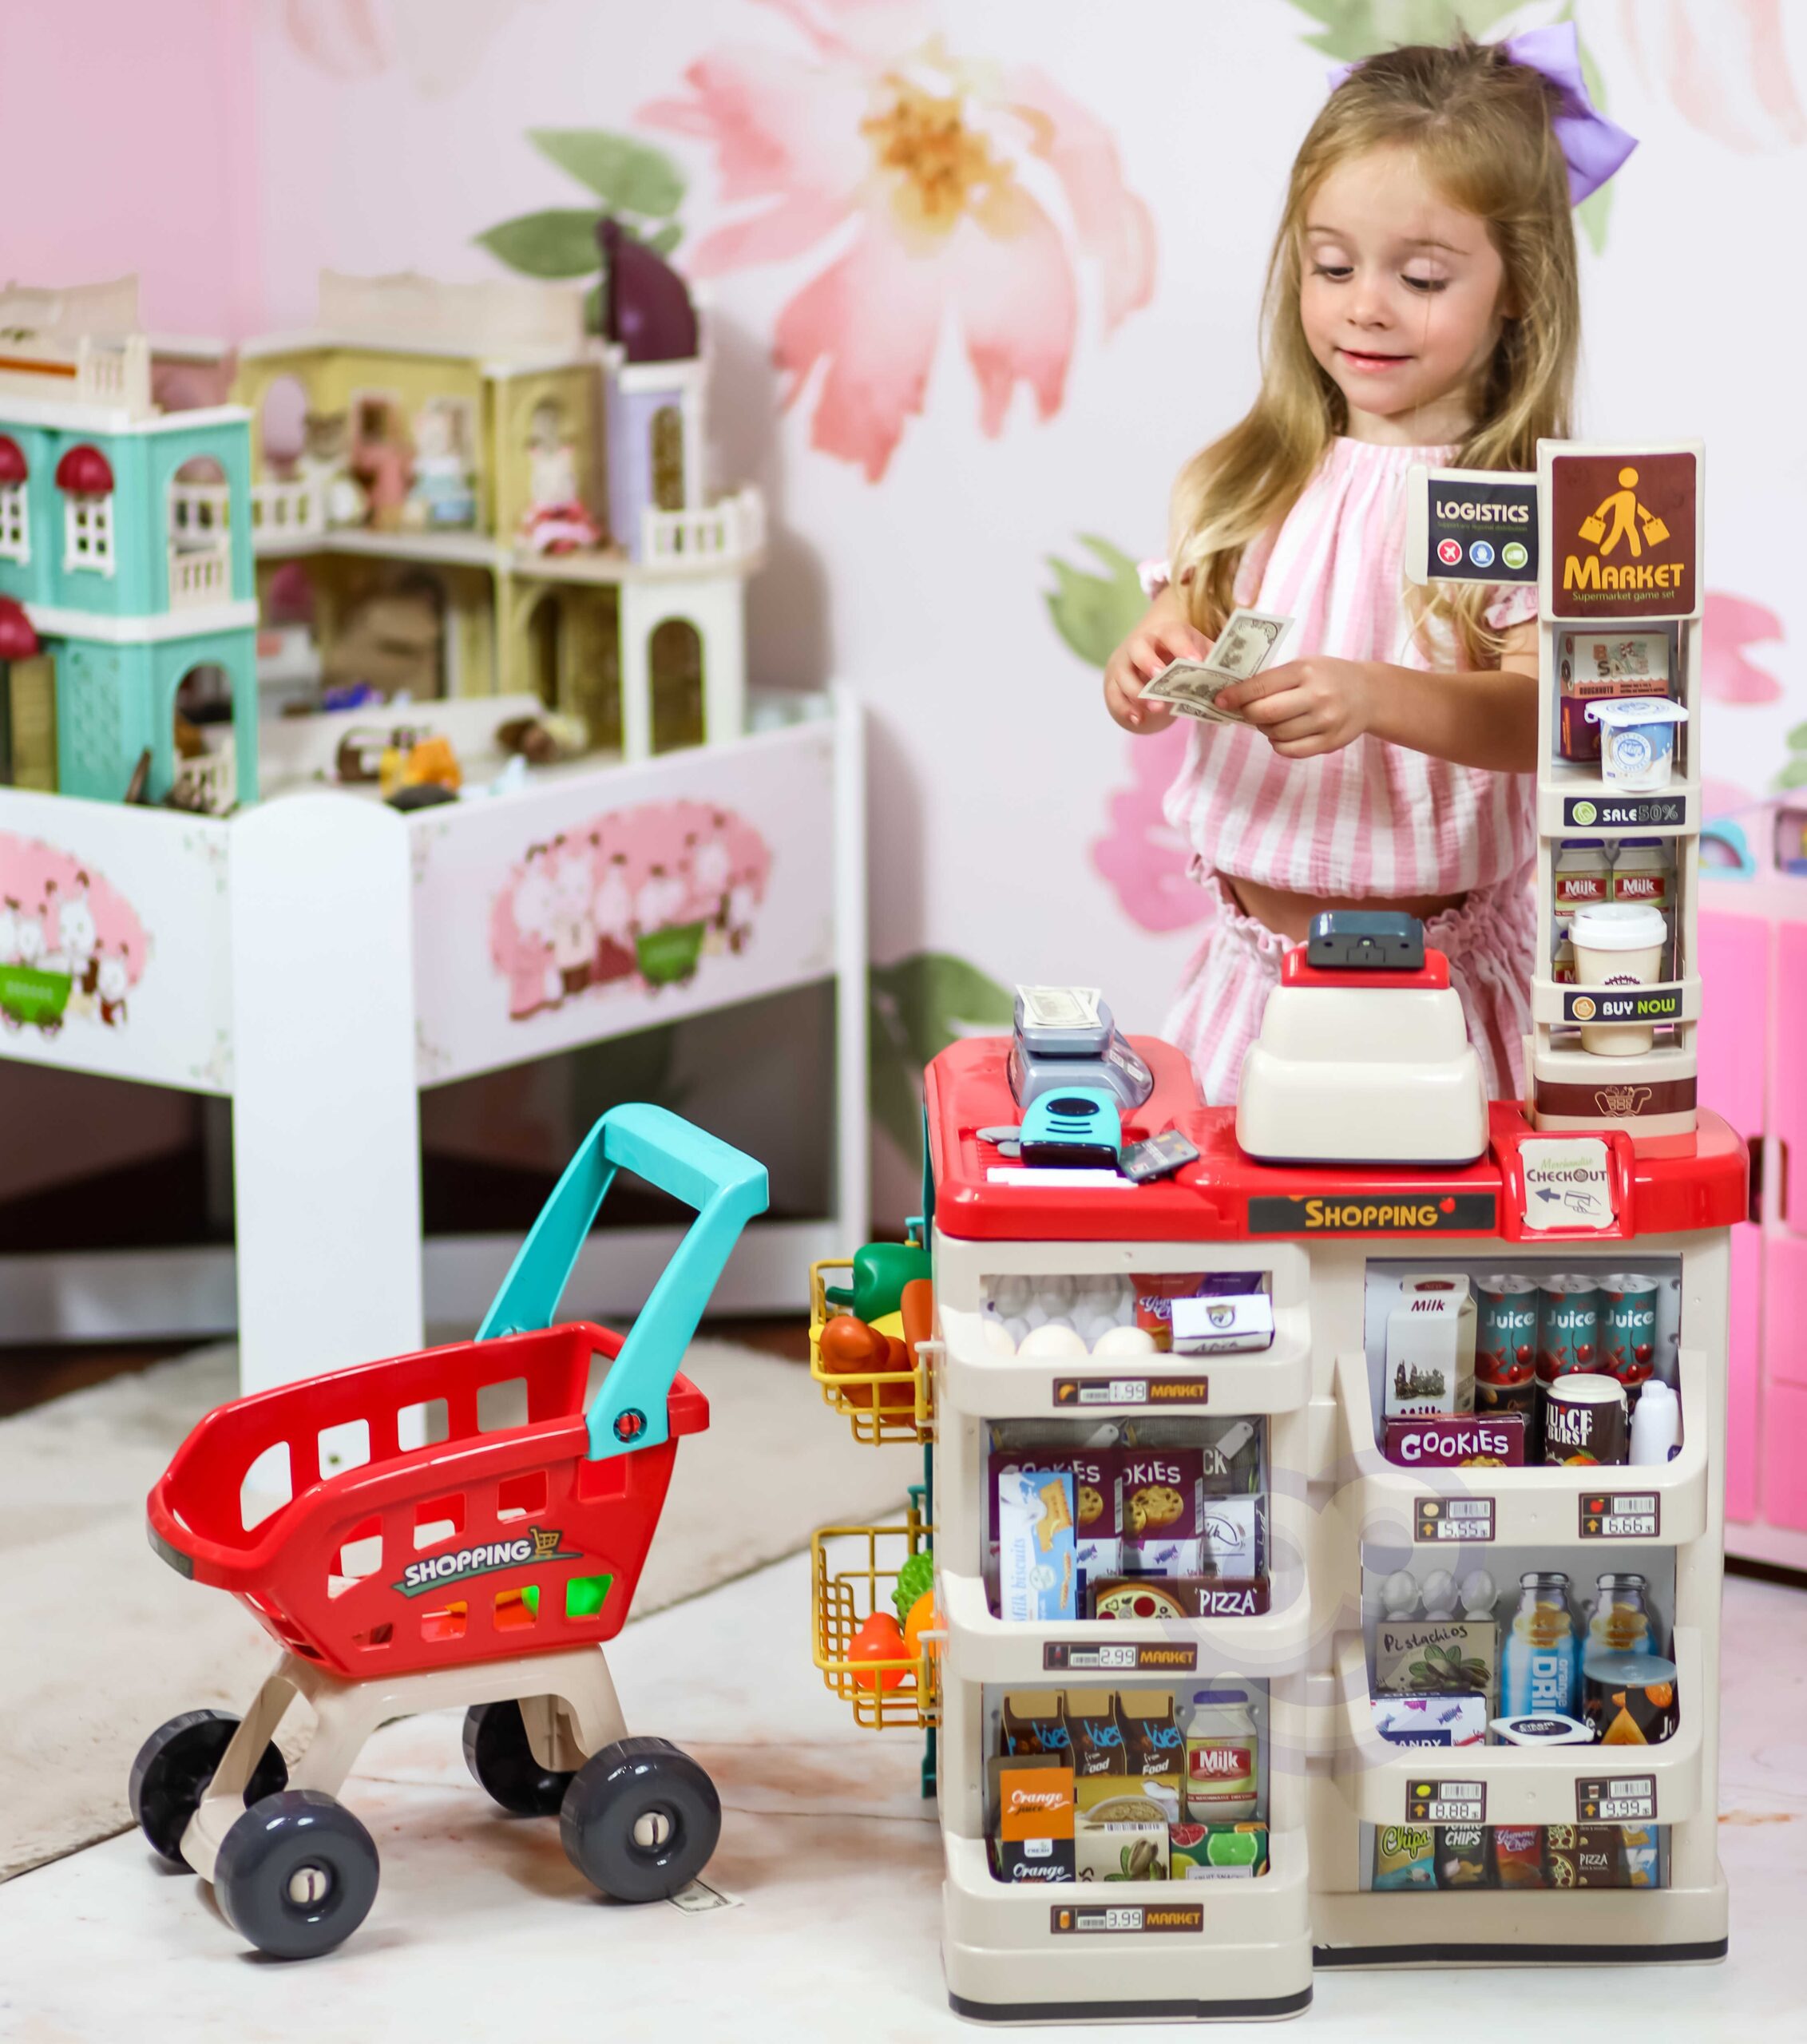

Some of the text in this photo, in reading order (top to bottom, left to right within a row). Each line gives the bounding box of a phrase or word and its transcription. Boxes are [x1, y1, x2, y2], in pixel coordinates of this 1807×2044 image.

[1436, 501, 1529, 523] LOGISTICS
[1572, 589, 1675, 602] Supermarket game set
[1603, 803, 1678, 822] SALE 50%
[1565, 880, 1598, 897] Milk
[1623, 878, 1655, 895] Milk
[1603, 998, 1676, 1016] BUY NOW
[1527, 1168, 1607, 1183] CHECKOUT
[1305, 1199, 1439, 1228] SHOPPING
[1411, 1299, 1446, 1312] Milk
[1486, 1309, 1536, 1329] Juice
[1547, 1309, 1596, 1329] Juice
[1605, 1309, 1655, 1329] Juice
[1113, 1383, 1206, 1400] 1.99 MARKET
[1401, 1429, 1509, 1461] COOKIES
[1547, 1425, 1590, 1447] BURST
[1123, 1460, 1181, 1484] OKIES
[1444, 1520, 1478, 1538] 5.55
[1609, 1516, 1643, 1534] 6.66
[404, 1539, 532, 1588] SHOPPING
[1384, 1624, 1468, 1653] Pistachios
[1100, 1649, 1195, 1665] 2.99 MARKET
[1532, 1657, 1558, 1714] DRI
[1083, 1757, 1110, 1776] Food
[1143, 1758, 1170, 1777] Food
[1199, 1750, 1238, 1772] Milk
[1011, 1789, 1064, 1808] Orange
[1436, 1802, 1469, 1820] 8.88
[1607, 1800, 1640, 1818] 9.99
[1381, 1825, 1432, 1860] Chips
[1444, 1831, 1482, 1846] CHIPS
[1012, 1863, 1065, 1881] Orange
[1108, 1911, 1201, 1928] 3.99 MARKET
